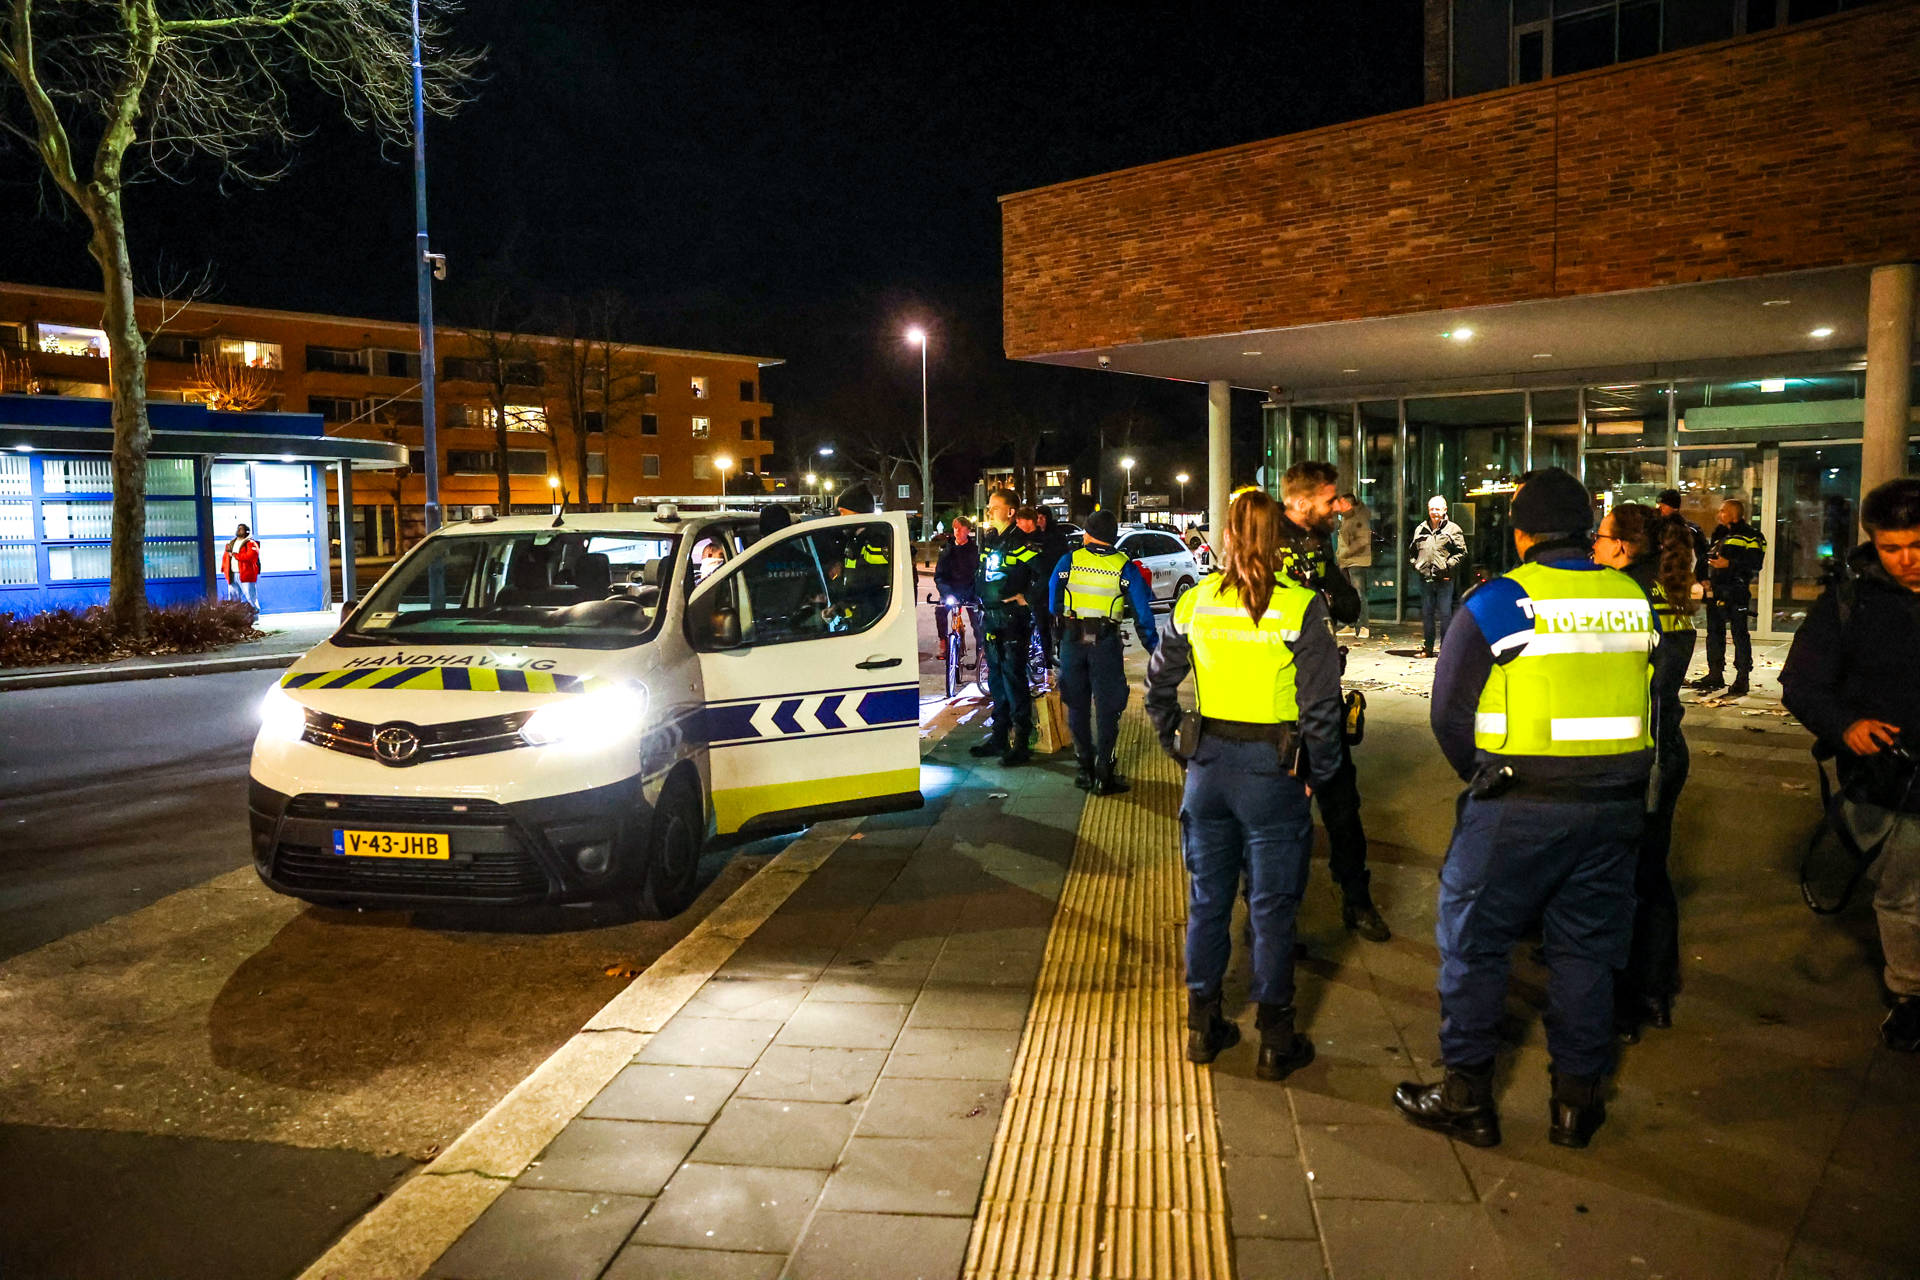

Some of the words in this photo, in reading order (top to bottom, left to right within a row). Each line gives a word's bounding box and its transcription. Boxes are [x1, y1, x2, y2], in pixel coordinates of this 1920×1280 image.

[1542, 610, 1650, 633] TOEZICHT
[343, 654, 558, 671] HANDHAVG
[349, 833, 438, 855] V-43-JHB
